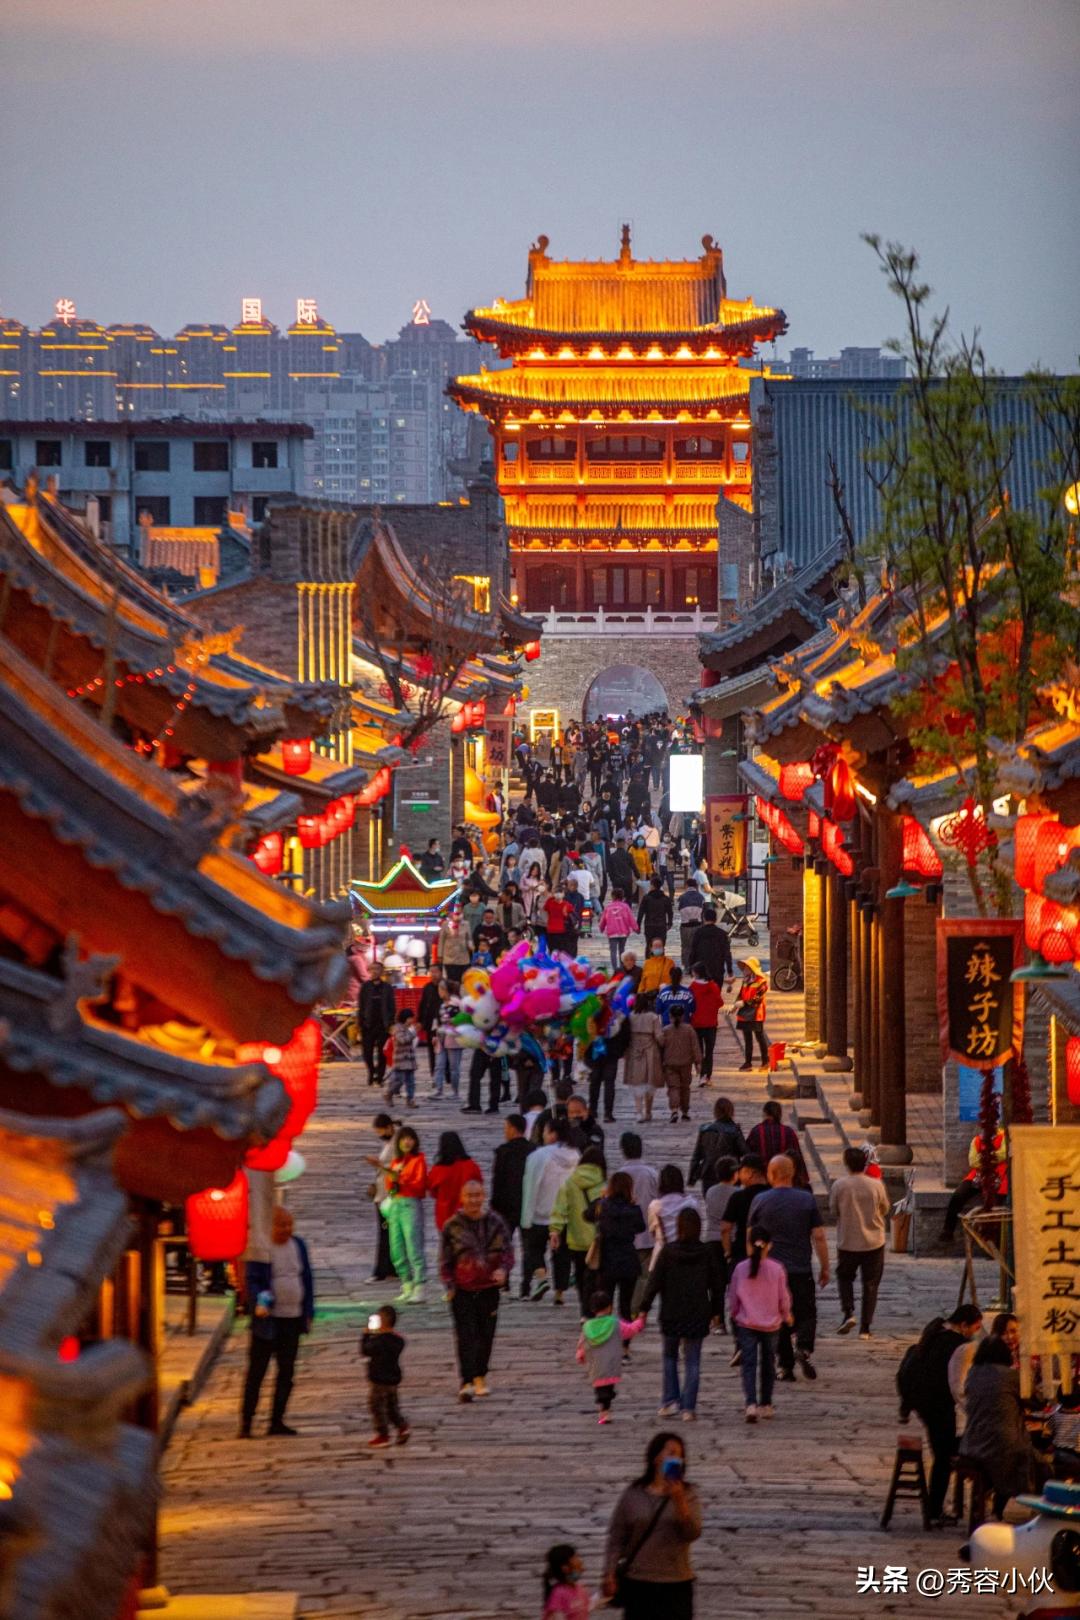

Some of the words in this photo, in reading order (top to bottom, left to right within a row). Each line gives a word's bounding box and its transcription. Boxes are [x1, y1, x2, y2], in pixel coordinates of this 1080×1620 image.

[964, 953, 1001, 1056] 辣子坊
[1040, 1175, 1080, 1334] 手工土豆粉
